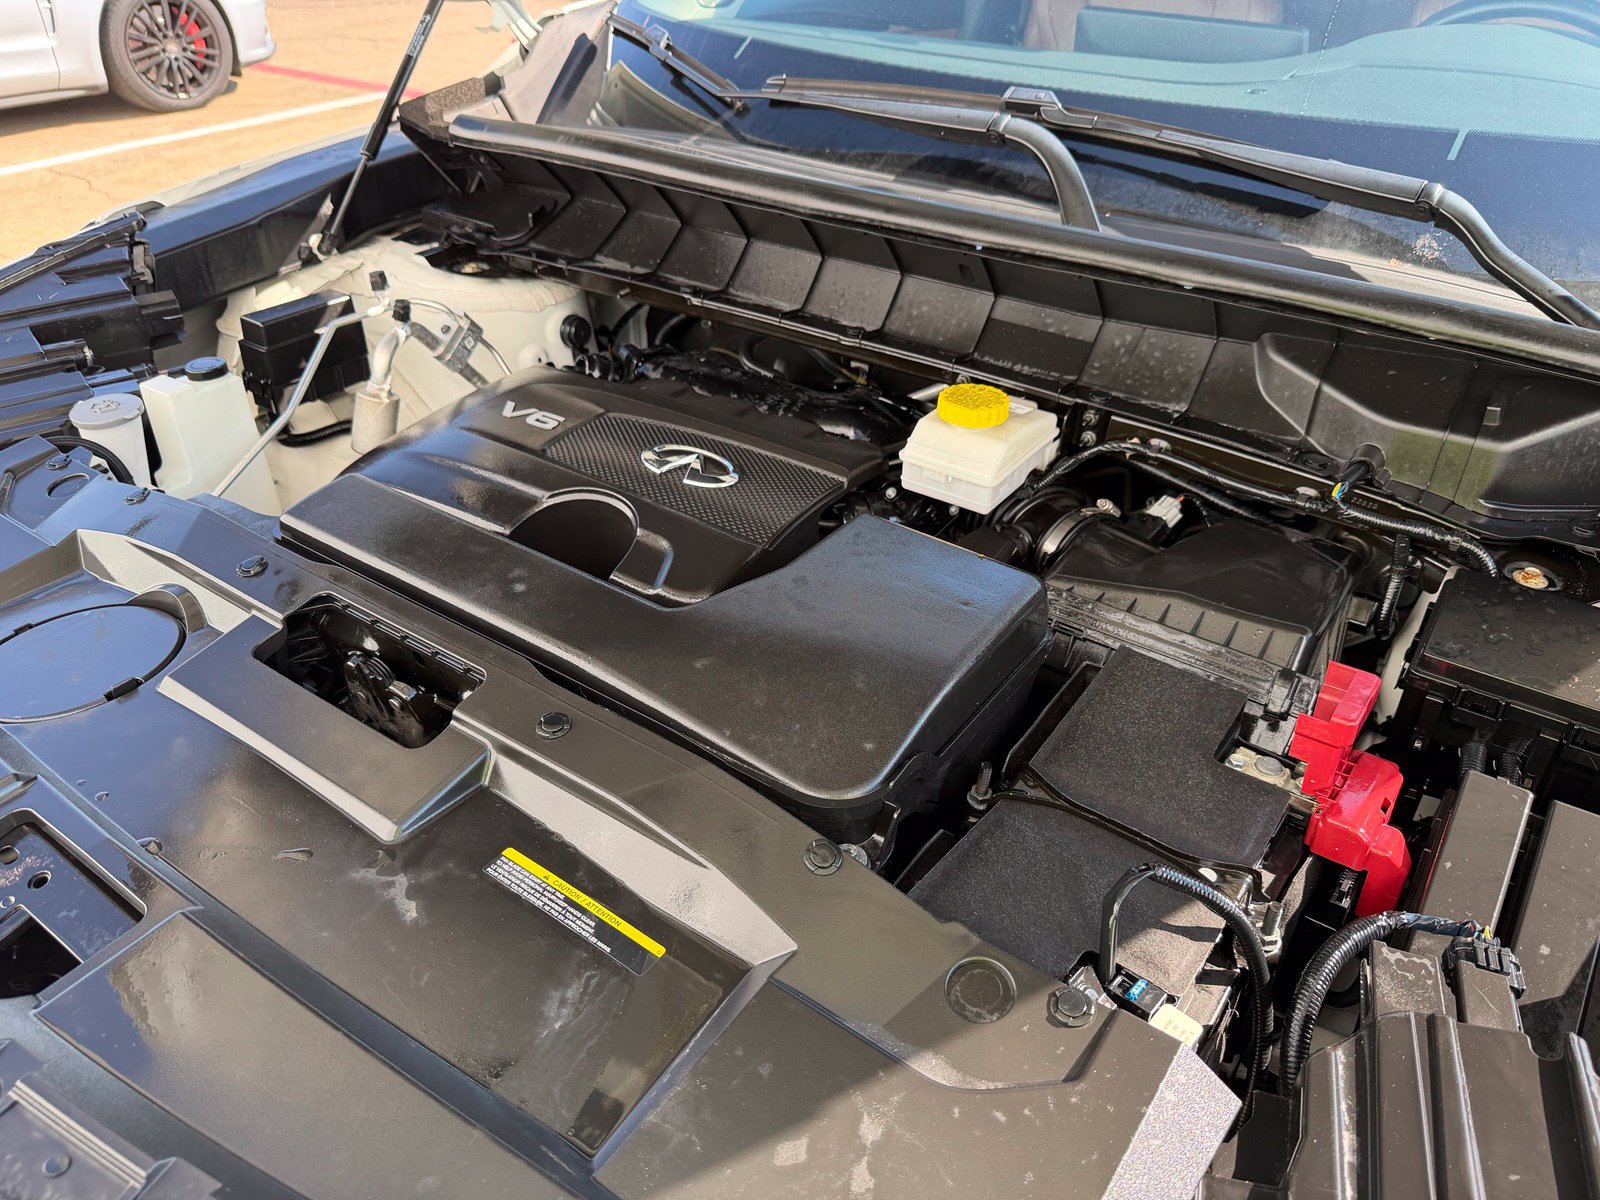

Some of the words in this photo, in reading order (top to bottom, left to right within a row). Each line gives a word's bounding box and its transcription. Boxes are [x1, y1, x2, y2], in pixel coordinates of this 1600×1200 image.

[502, 401, 565, 430] V6
[495, 867, 520, 884] VENTILATEUR
[519, 883, 535, 893] RISQUE
[539, 895, 563, 911] DÉMARRER
[564, 912, 576, 921] TOUT
[501, 863, 512, 871] HELP
[511, 870, 524, 879] AVOID
[523, 878, 544, 892] PERSONAL
[565, 906, 581, 917] HANDS
[508, 861, 521, 870] BLADE
[529, 875, 541, 883] START
[486, 868, 498, 876] POUR
[510, 883, 523, 893] TOUTE
[563, 919, 589, 937] APPROCHER
[552, 880, 581, 899] CAUTION
[585, 901, 621, 926] ATTENTION
